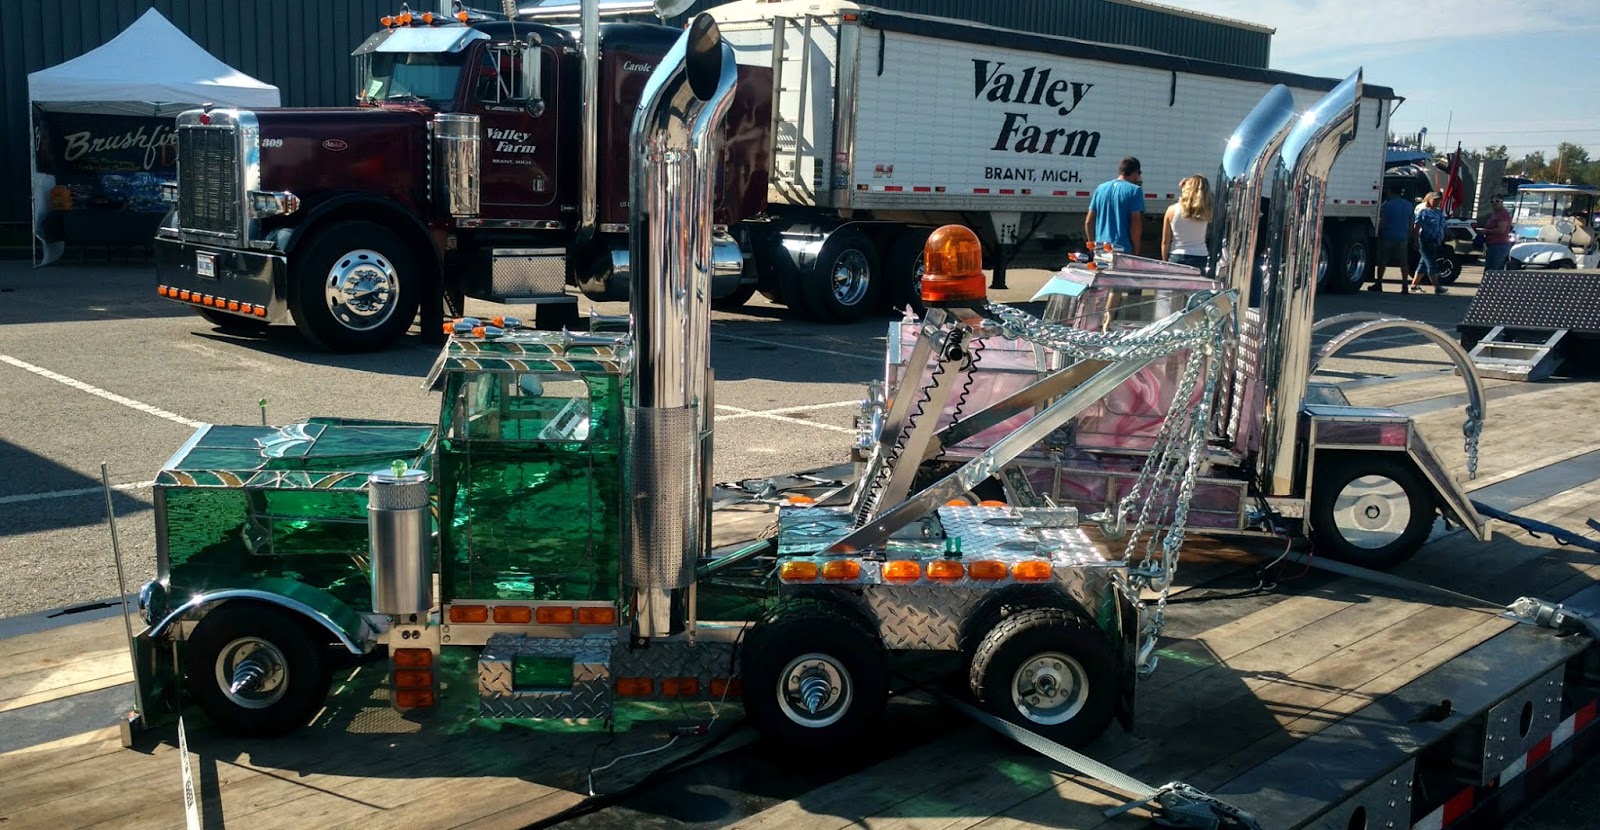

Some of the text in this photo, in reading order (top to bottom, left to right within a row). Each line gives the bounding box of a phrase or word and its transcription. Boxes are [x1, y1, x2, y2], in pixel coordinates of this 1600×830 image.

[971, 58, 1095, 116] Valley
[261, 138, 284, 148] 309
[487, 127, 532, 142] Valley
[990, 112, 1101, 158] Farm
[63, 124, 177, 170] Brushfir
[495, 140, 536, 153] Farm
[984, 166, 1082, 183] BRANT, MICH.
